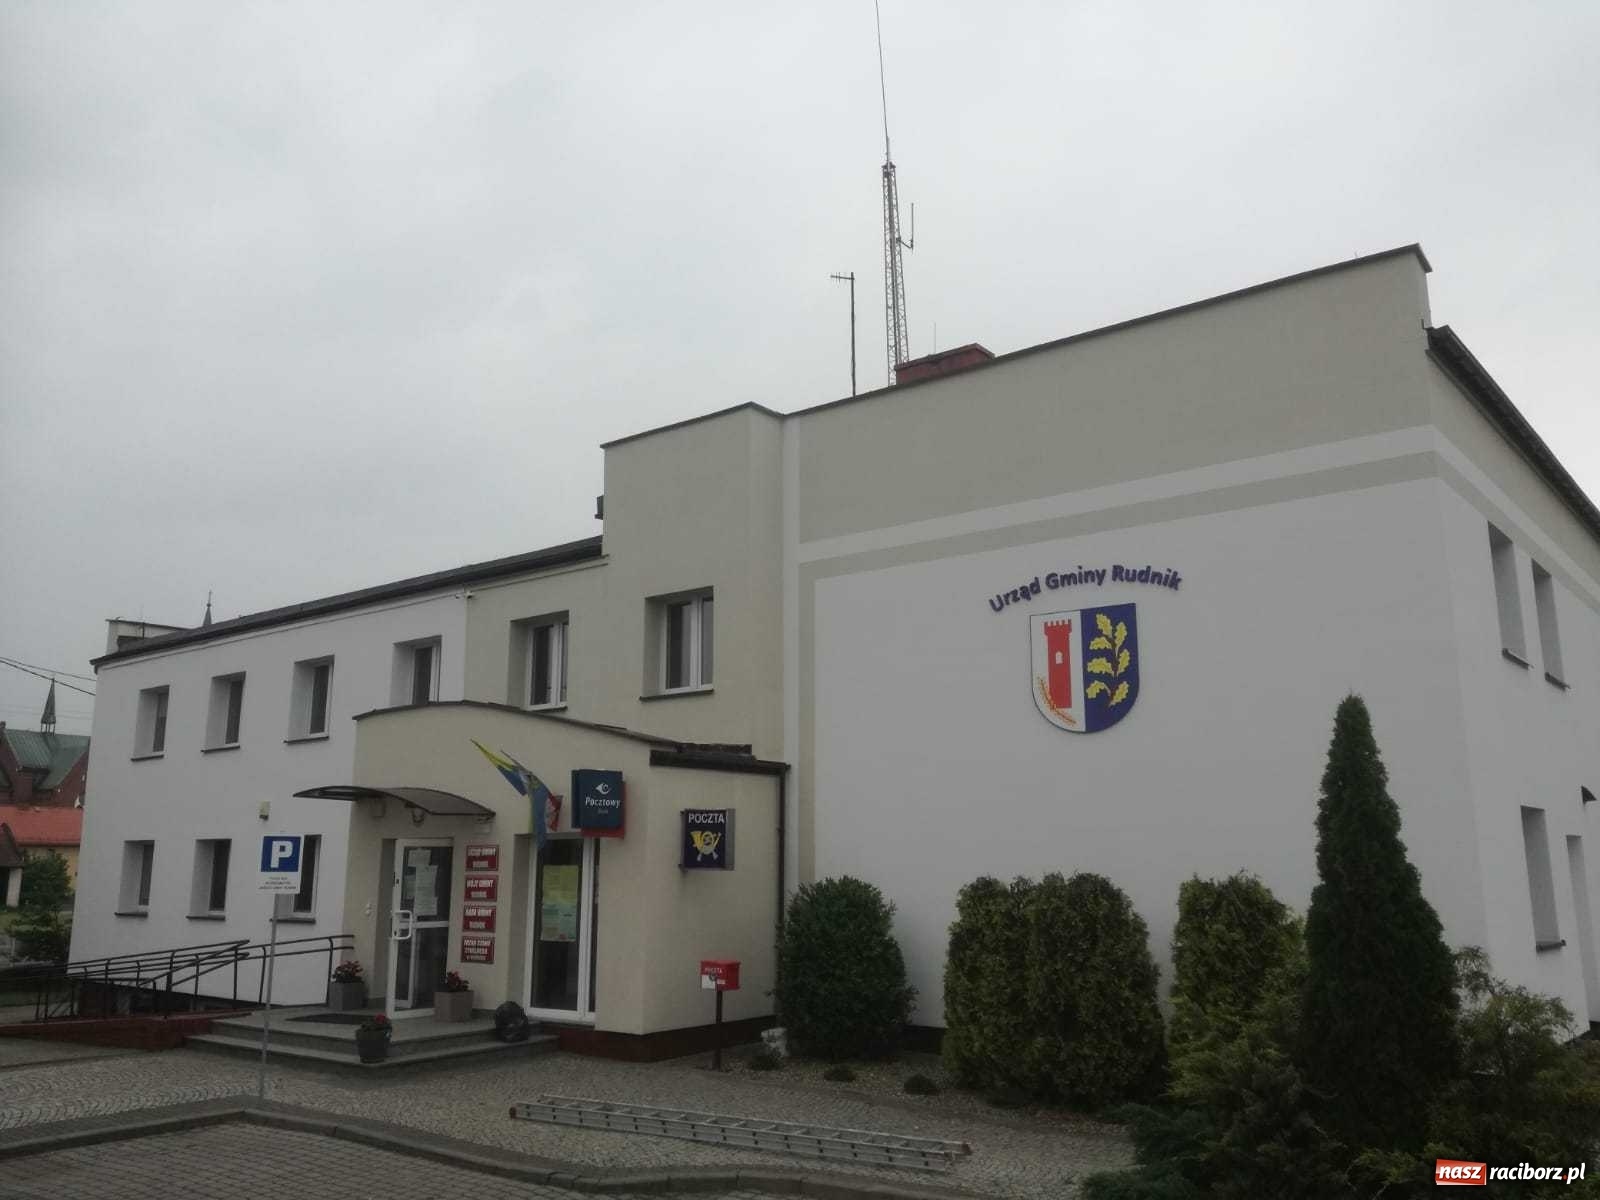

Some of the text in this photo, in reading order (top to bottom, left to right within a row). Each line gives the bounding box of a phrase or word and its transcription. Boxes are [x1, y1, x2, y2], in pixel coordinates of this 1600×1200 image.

[989, 565, 1182, 612] Urząd Gminy Rudnik
[585, 796, 620, 808] Pocztowy
[688, 813, 725, 824] POCZTA
[270, 840, 293, 868] P
